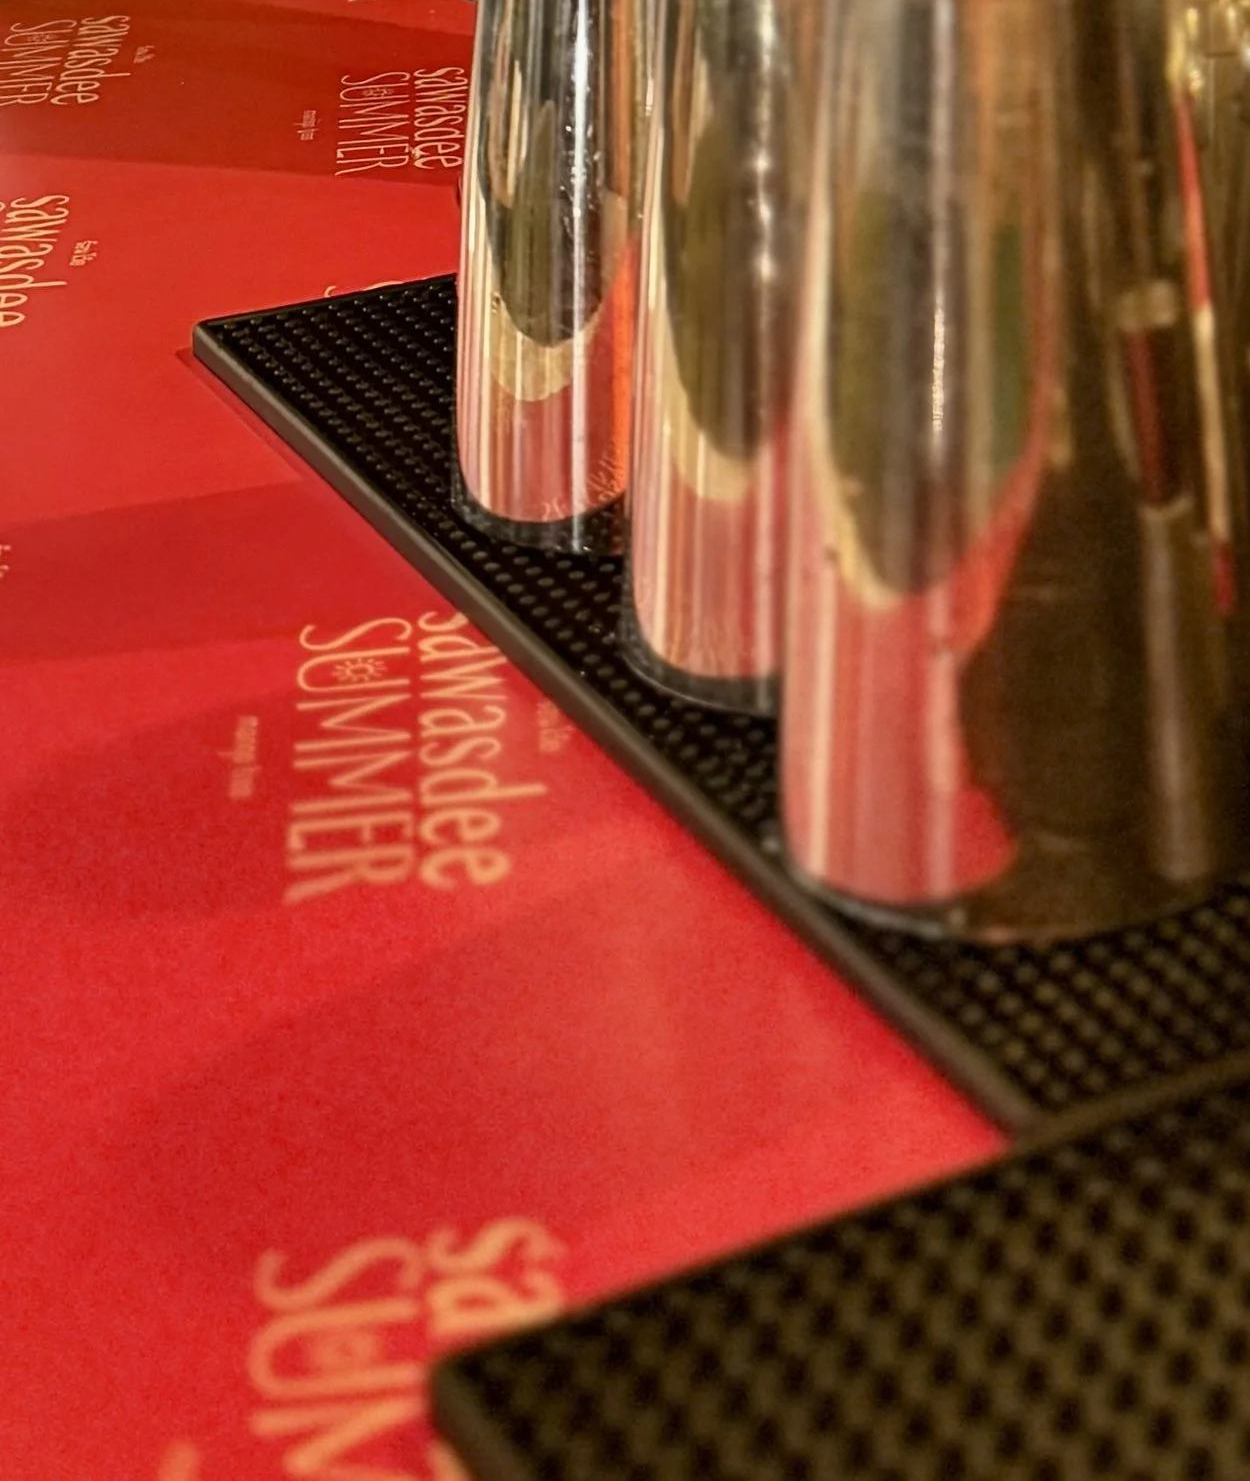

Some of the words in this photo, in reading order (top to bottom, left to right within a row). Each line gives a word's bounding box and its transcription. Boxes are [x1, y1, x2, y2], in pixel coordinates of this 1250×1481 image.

[50, 15, 131, 106] sawasdee
[334, 71, 411, 176] SUMMER
[413, 66, 468, 170] sawasdee
[284, 617, 413, 906] SUMMER
[418, 611, 547, 890] sawasdee
